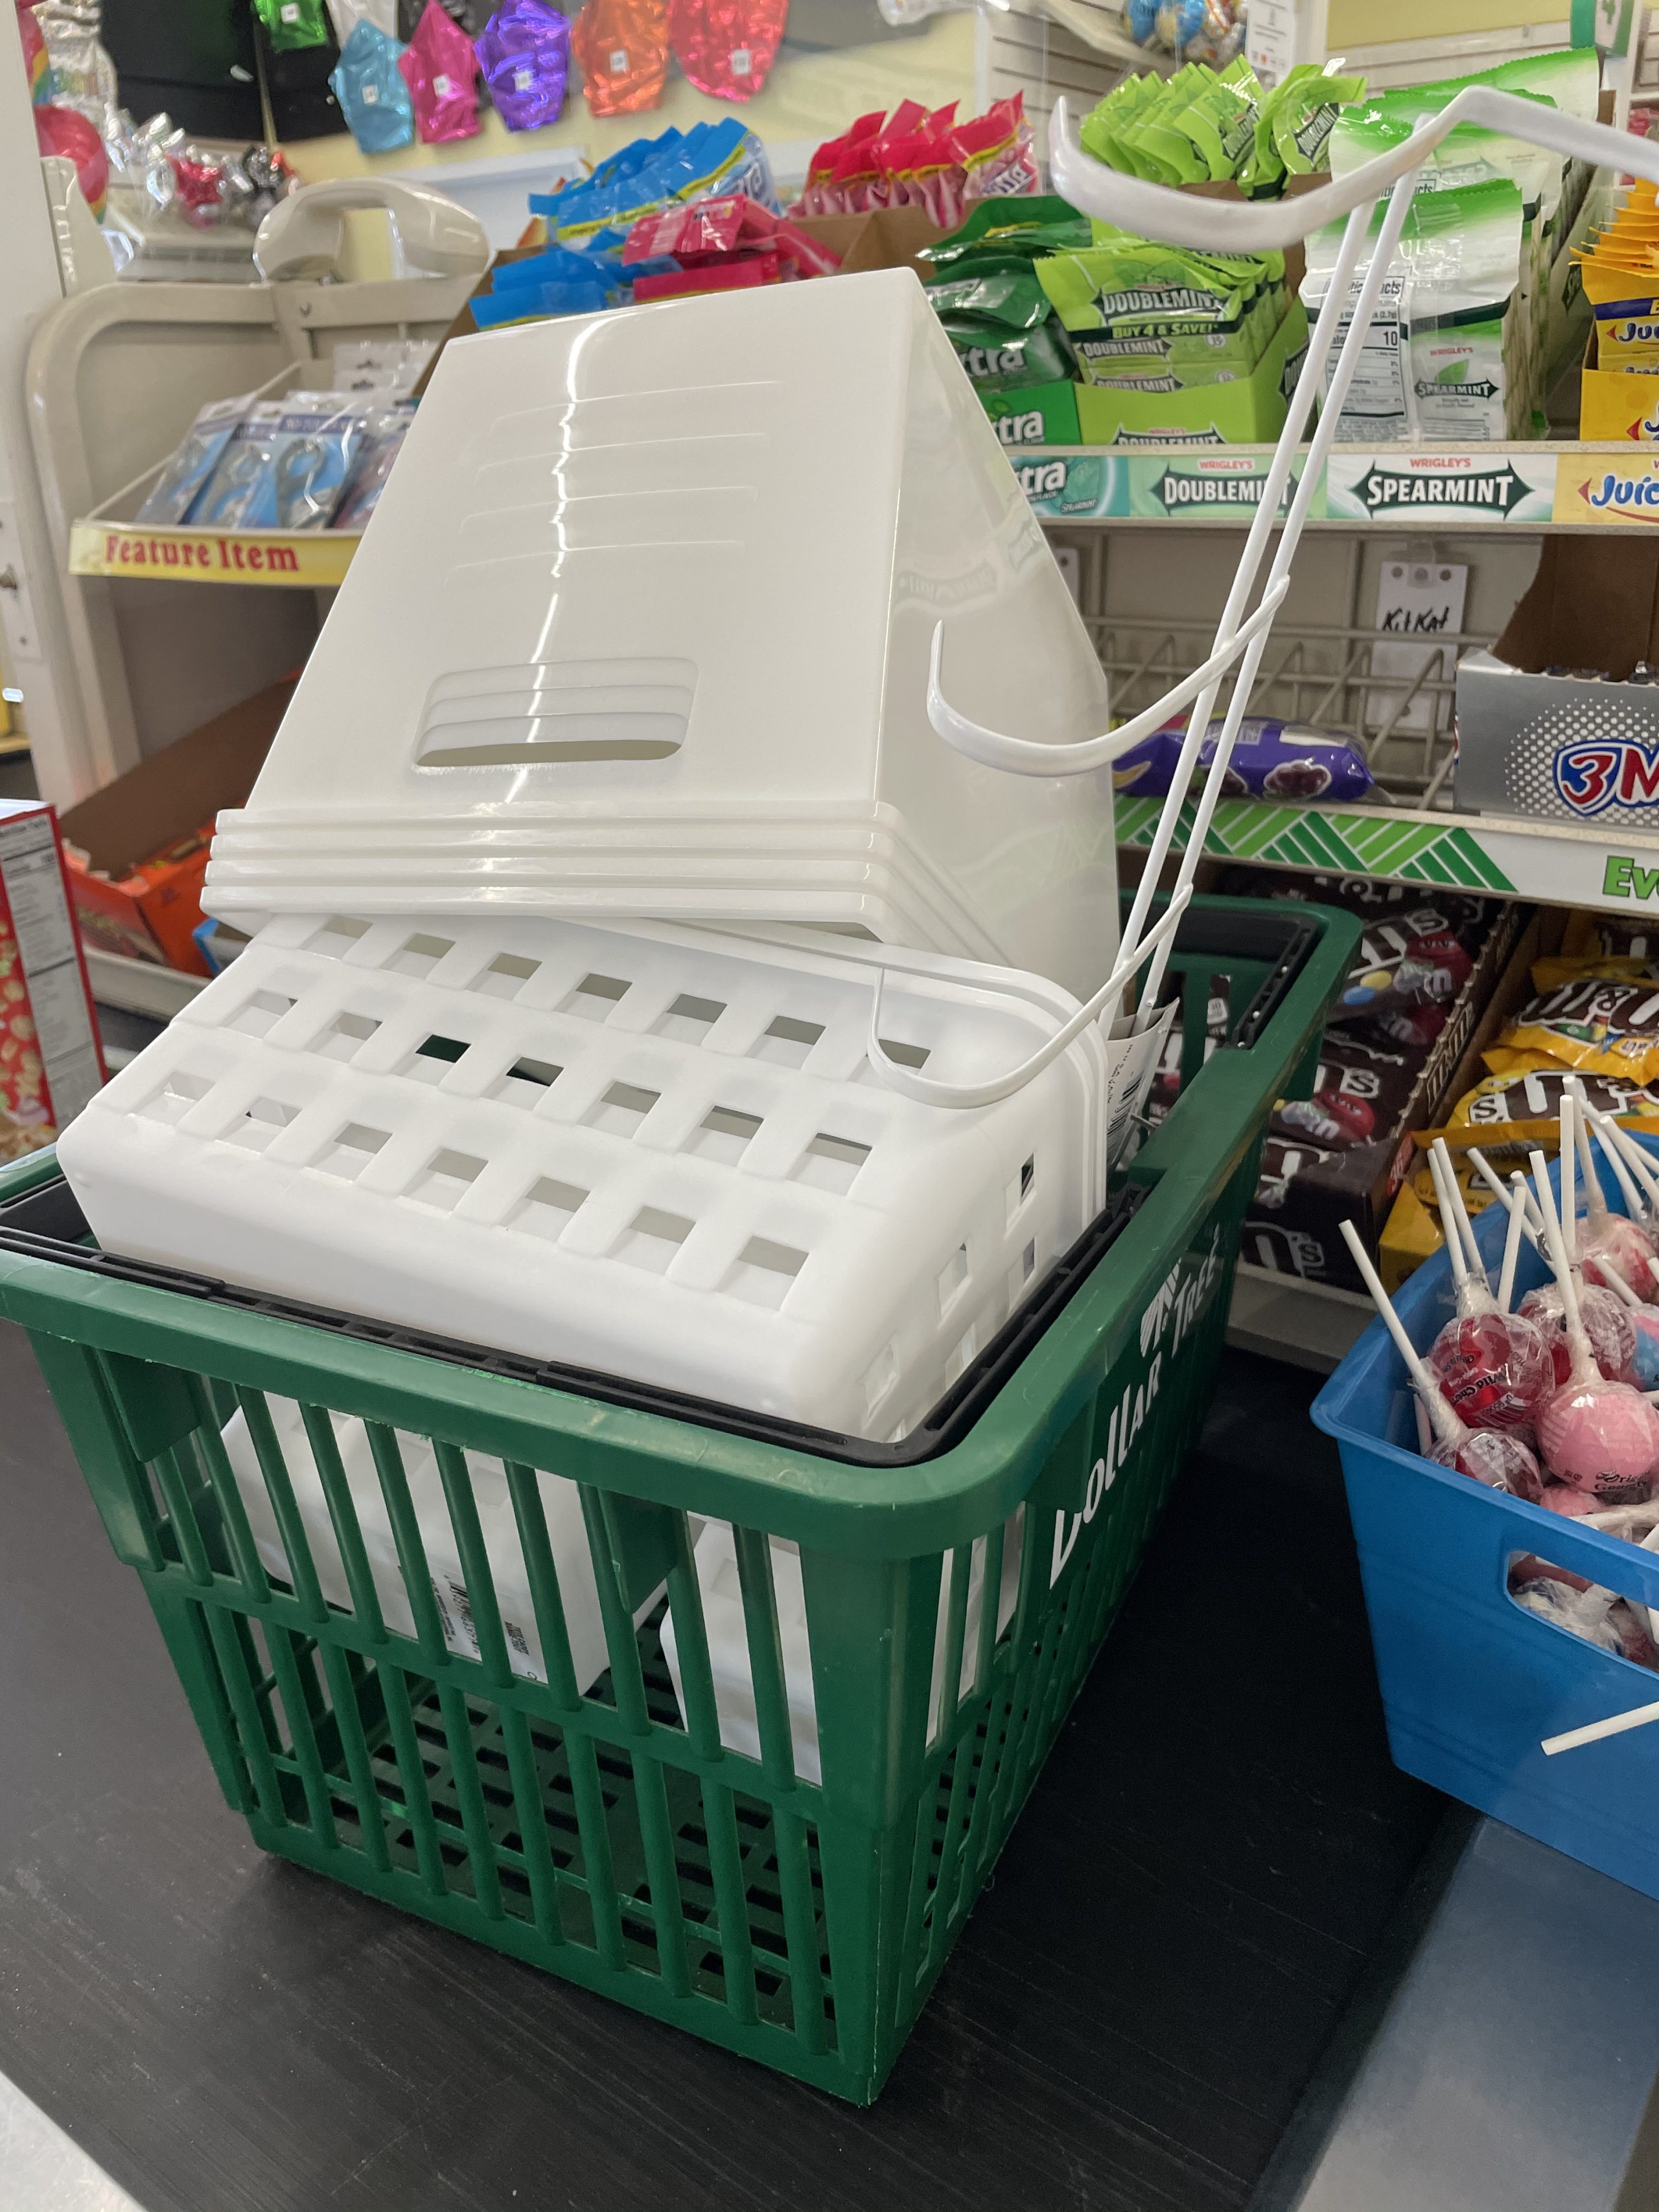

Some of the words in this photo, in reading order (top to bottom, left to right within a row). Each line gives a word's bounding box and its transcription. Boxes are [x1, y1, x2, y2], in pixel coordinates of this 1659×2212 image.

[1113, 325, 1140, 338] BUY
[1143, 325, 1154, 336] 4
[1157, 323, 1167, 336] &
[1383, 331, 1398, 346] 10
[1083, 338, 1165, 356] DOUBLEMINT
[1430, 347, 1474, 356] WRIGLEY'S
[961, 347, 1025, 377] tra
[1418, 382, 1490, 397] SPEARMINT
[992, 411, 1044, 445] tra
[1199, 460, 1254, 469] WRIGLEY'S
[1410, 458, 1472, 468] WRIGLEY'S
[1015, 461, 1067, 496] tra
[1164, 476, 1292, 505] DOUBLEMIT
[1366, 475, 1514, 506] SPEARMINT
[1591, 475, 1659, 506] Juic
[106, 535, 211, 568] Feature
[217, 539, 299, 571] Item
[1603, 854, 1659, 900] Ev
[1172, 1223, 1220, 1359] TREE
